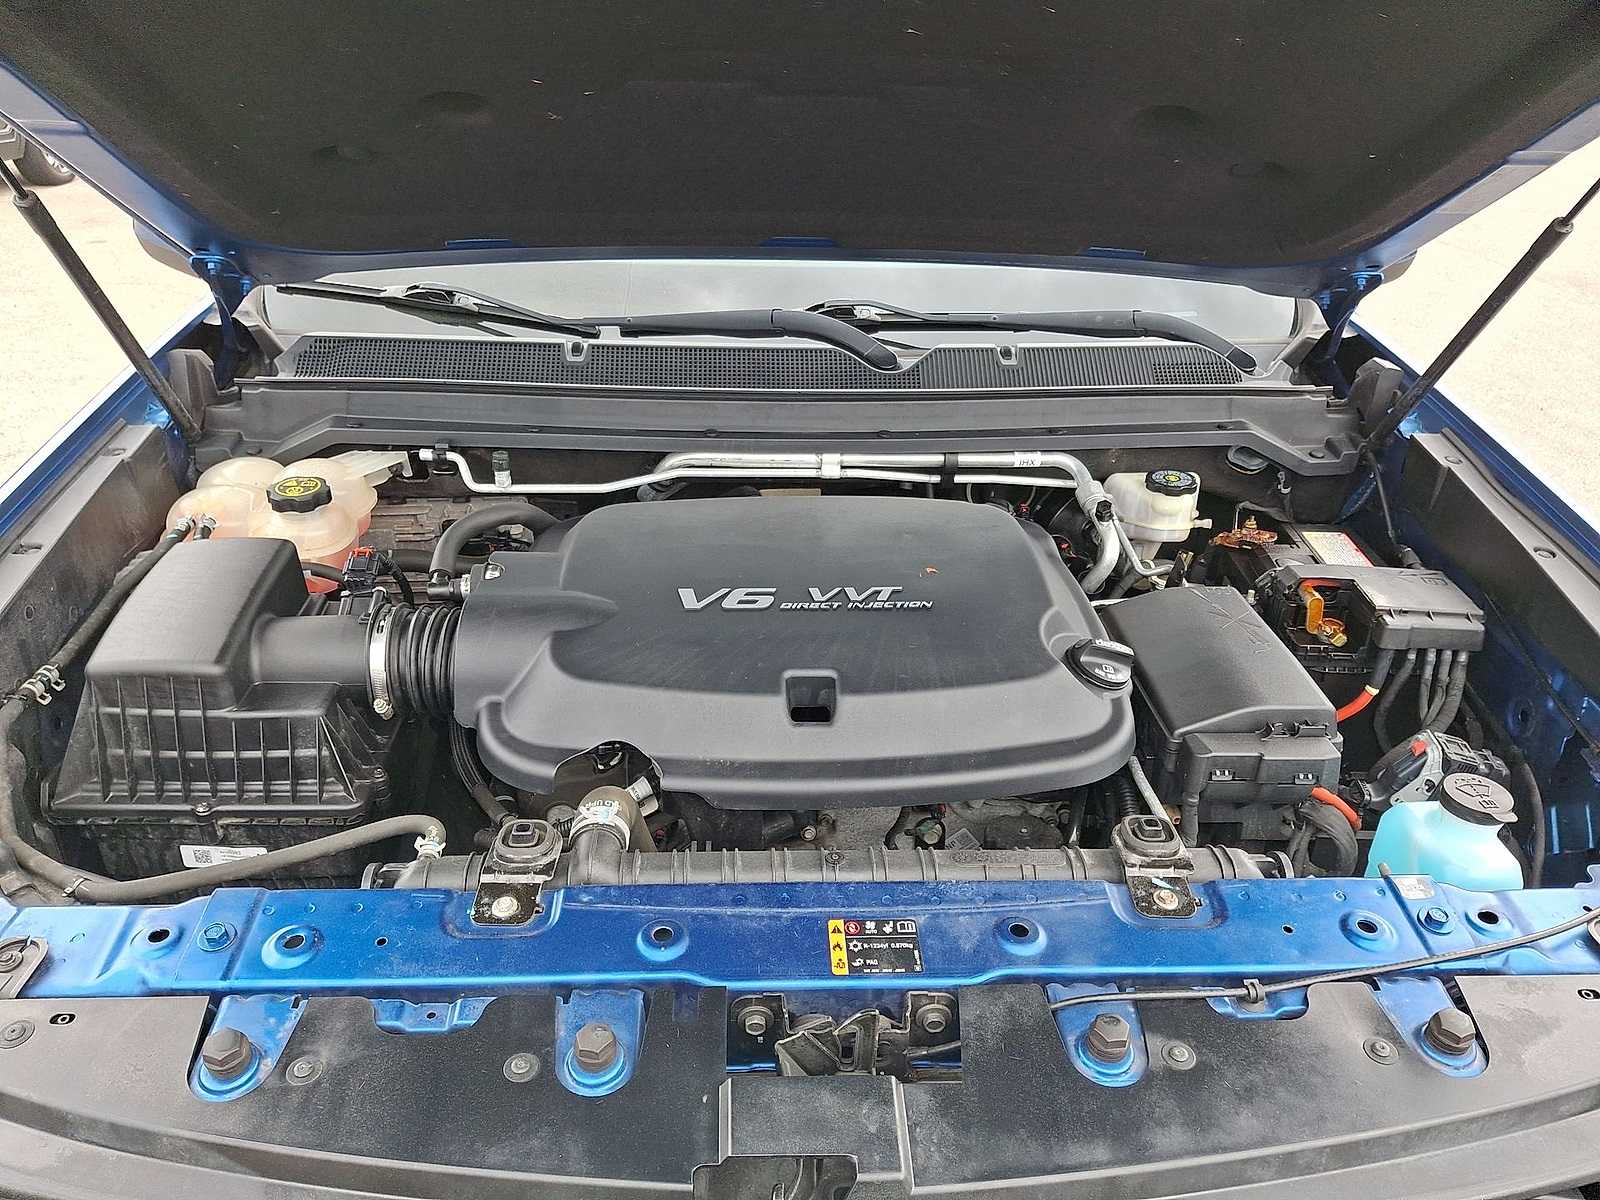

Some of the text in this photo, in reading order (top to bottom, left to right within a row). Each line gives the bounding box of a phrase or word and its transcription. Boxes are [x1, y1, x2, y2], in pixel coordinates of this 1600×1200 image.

[677, 587, 777, 610] V6
[808, 586, 902, 601] VVT
[779, 600, 933, 610] DIRECT INJECTION
